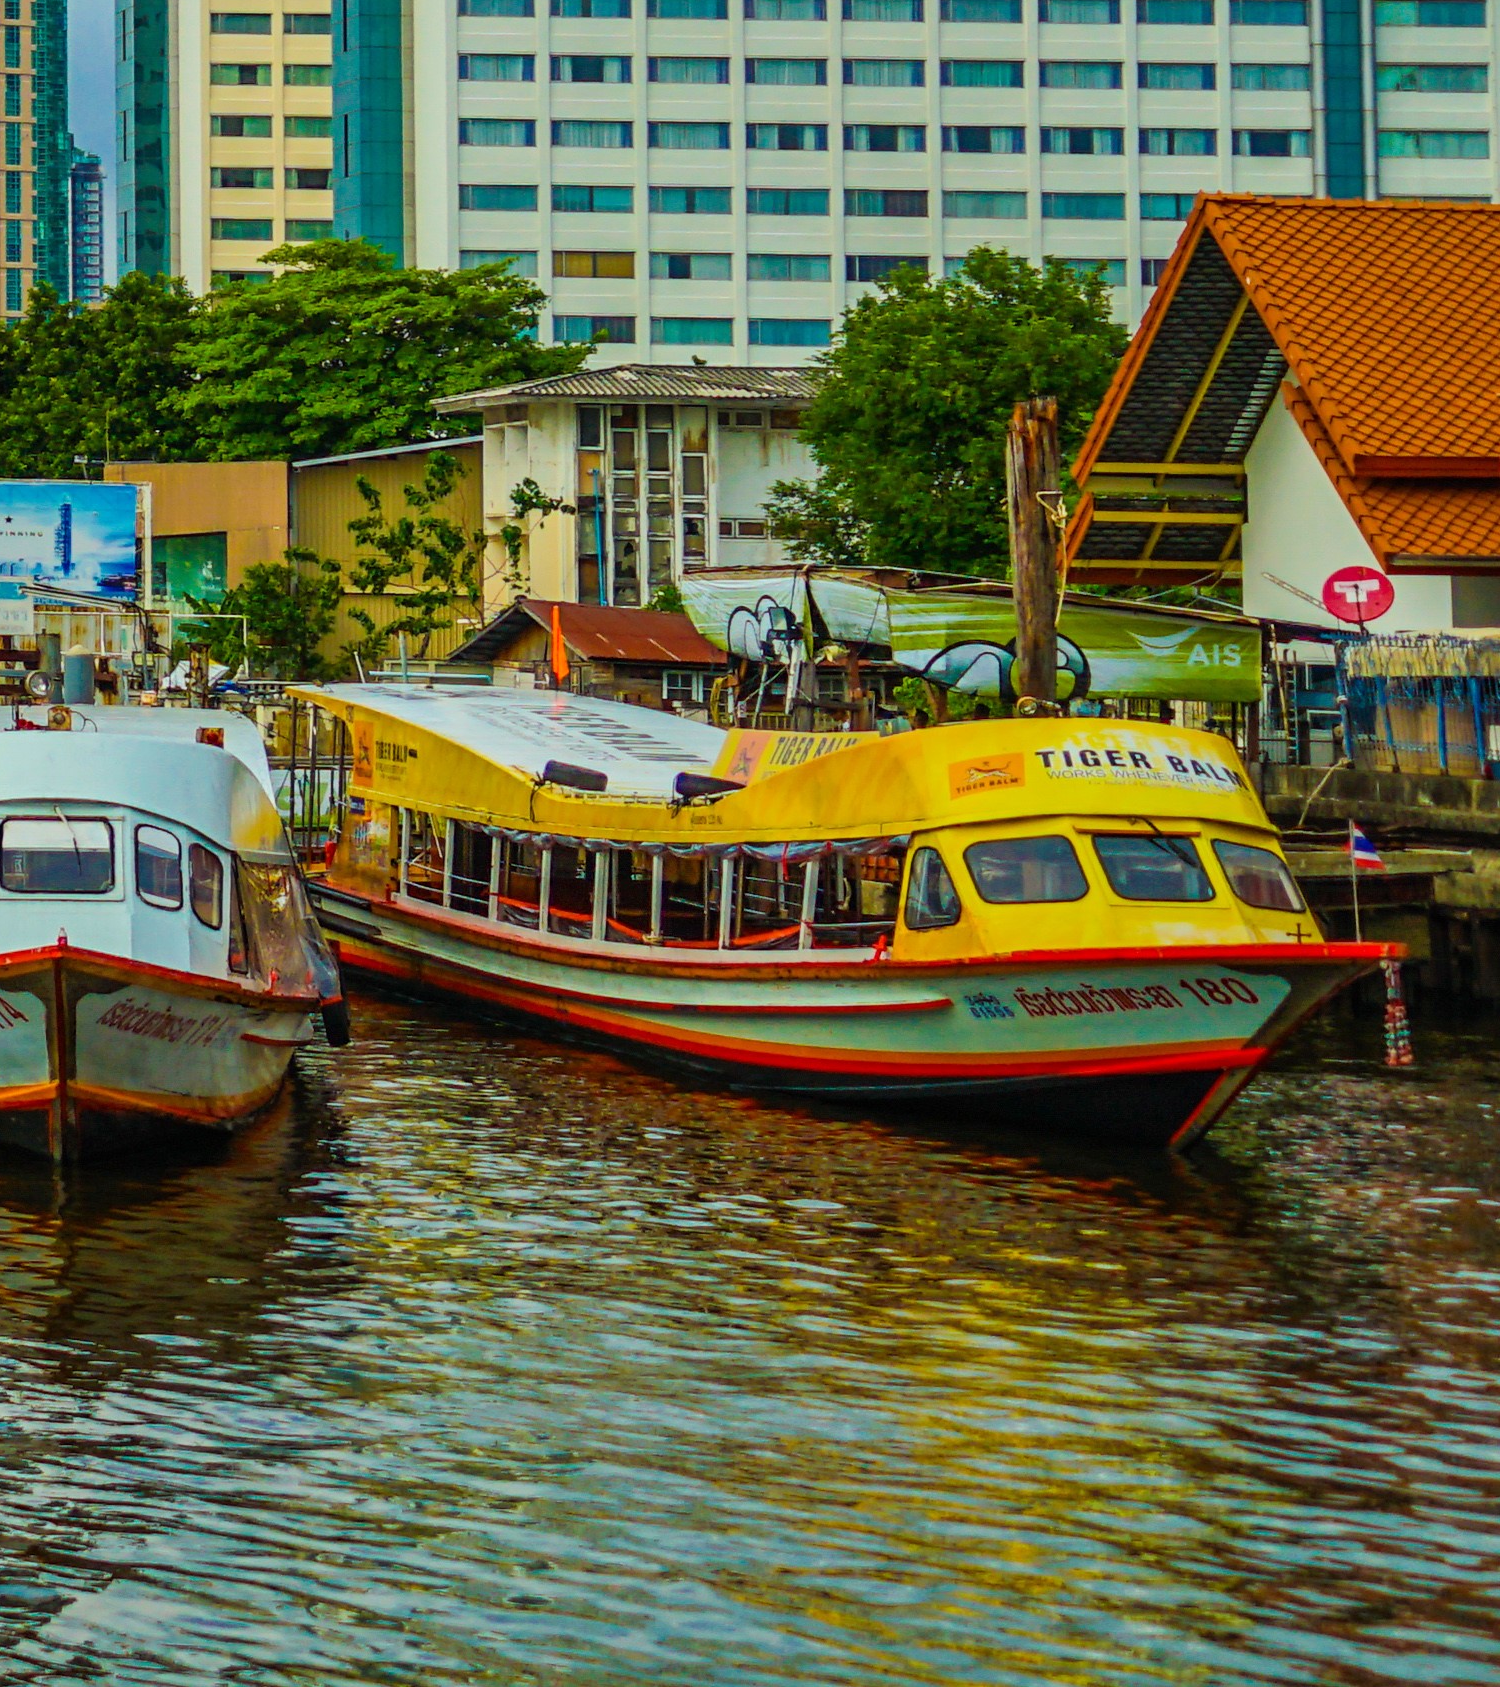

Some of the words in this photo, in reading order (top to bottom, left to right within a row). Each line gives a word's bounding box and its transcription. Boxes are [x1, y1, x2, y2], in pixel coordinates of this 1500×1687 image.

[1188, 643, 1242, 667] AIS
[769, 736, 815, 765] TIGER
[1034, 749, 1154, 769] TIGER
[1165, 754, 1250, 792] BALM
[1046, 769, 1105, 779] WORKS
[1110, 767, 1194, 784] WHENEVER
[956, 782, 986, 794] TIGER
[989, 777, 1018, 788] BALM
[1013, 982, 1184, 1018] เรือด่วนเจ้าพระยา
[1179, 977, 1259, 1008] 180
